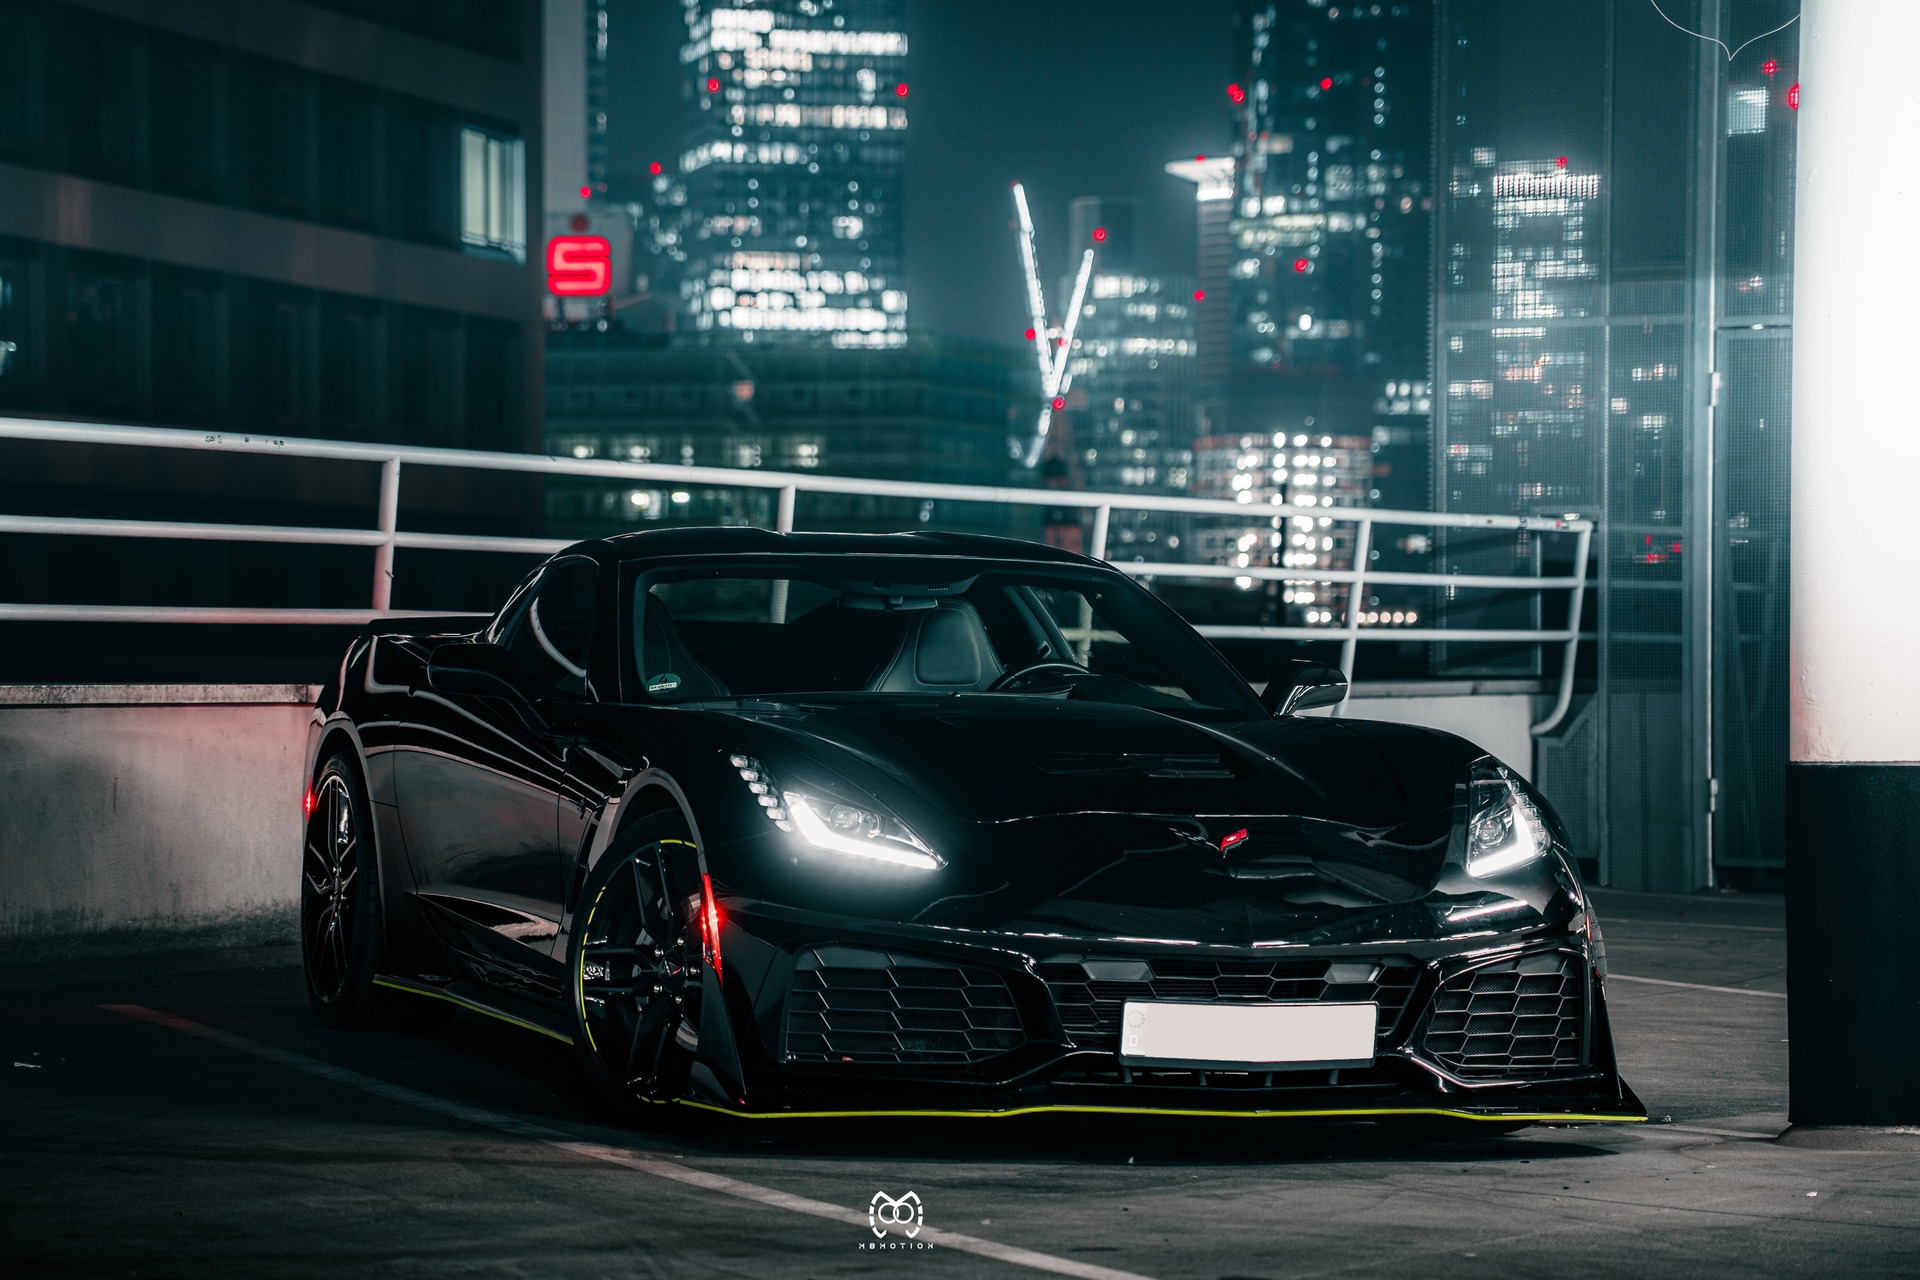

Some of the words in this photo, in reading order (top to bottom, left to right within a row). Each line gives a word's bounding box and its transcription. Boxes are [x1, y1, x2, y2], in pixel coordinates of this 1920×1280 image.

[547, 235, 611, 296] S
[658, 674, 669, 683] 4
[1130, 1035, 1138, 1046] D
